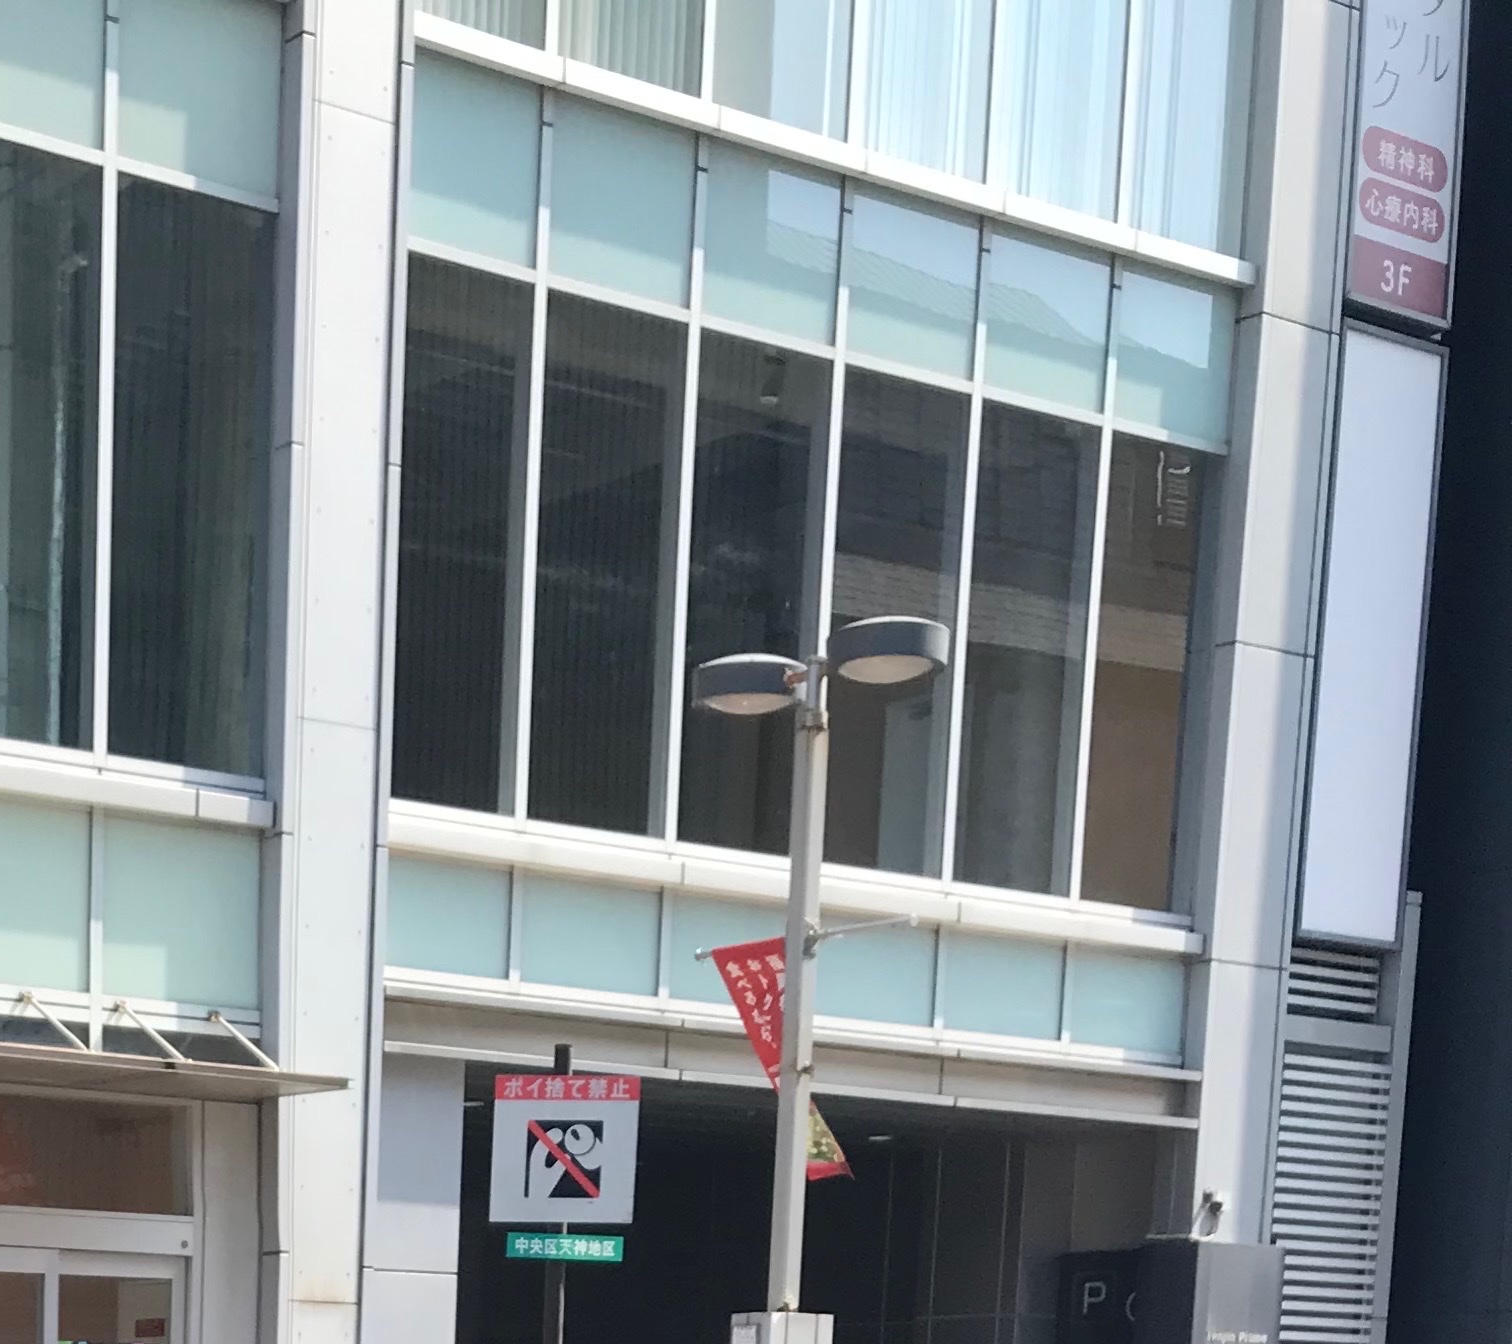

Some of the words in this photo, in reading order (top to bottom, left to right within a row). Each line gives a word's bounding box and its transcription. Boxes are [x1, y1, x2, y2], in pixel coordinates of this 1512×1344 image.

[1377, 139, 1434, 184] 精神科
[1365, 188, 1439, 236] 心療内科
[1380, 260, 1412, 296] 3F
[504, 1077, 630, 1099] ポイ捨て禁止
[515, 1237, 615, 1256] 中央区天神地区
[1082, 1281, 1106, 1315] P
